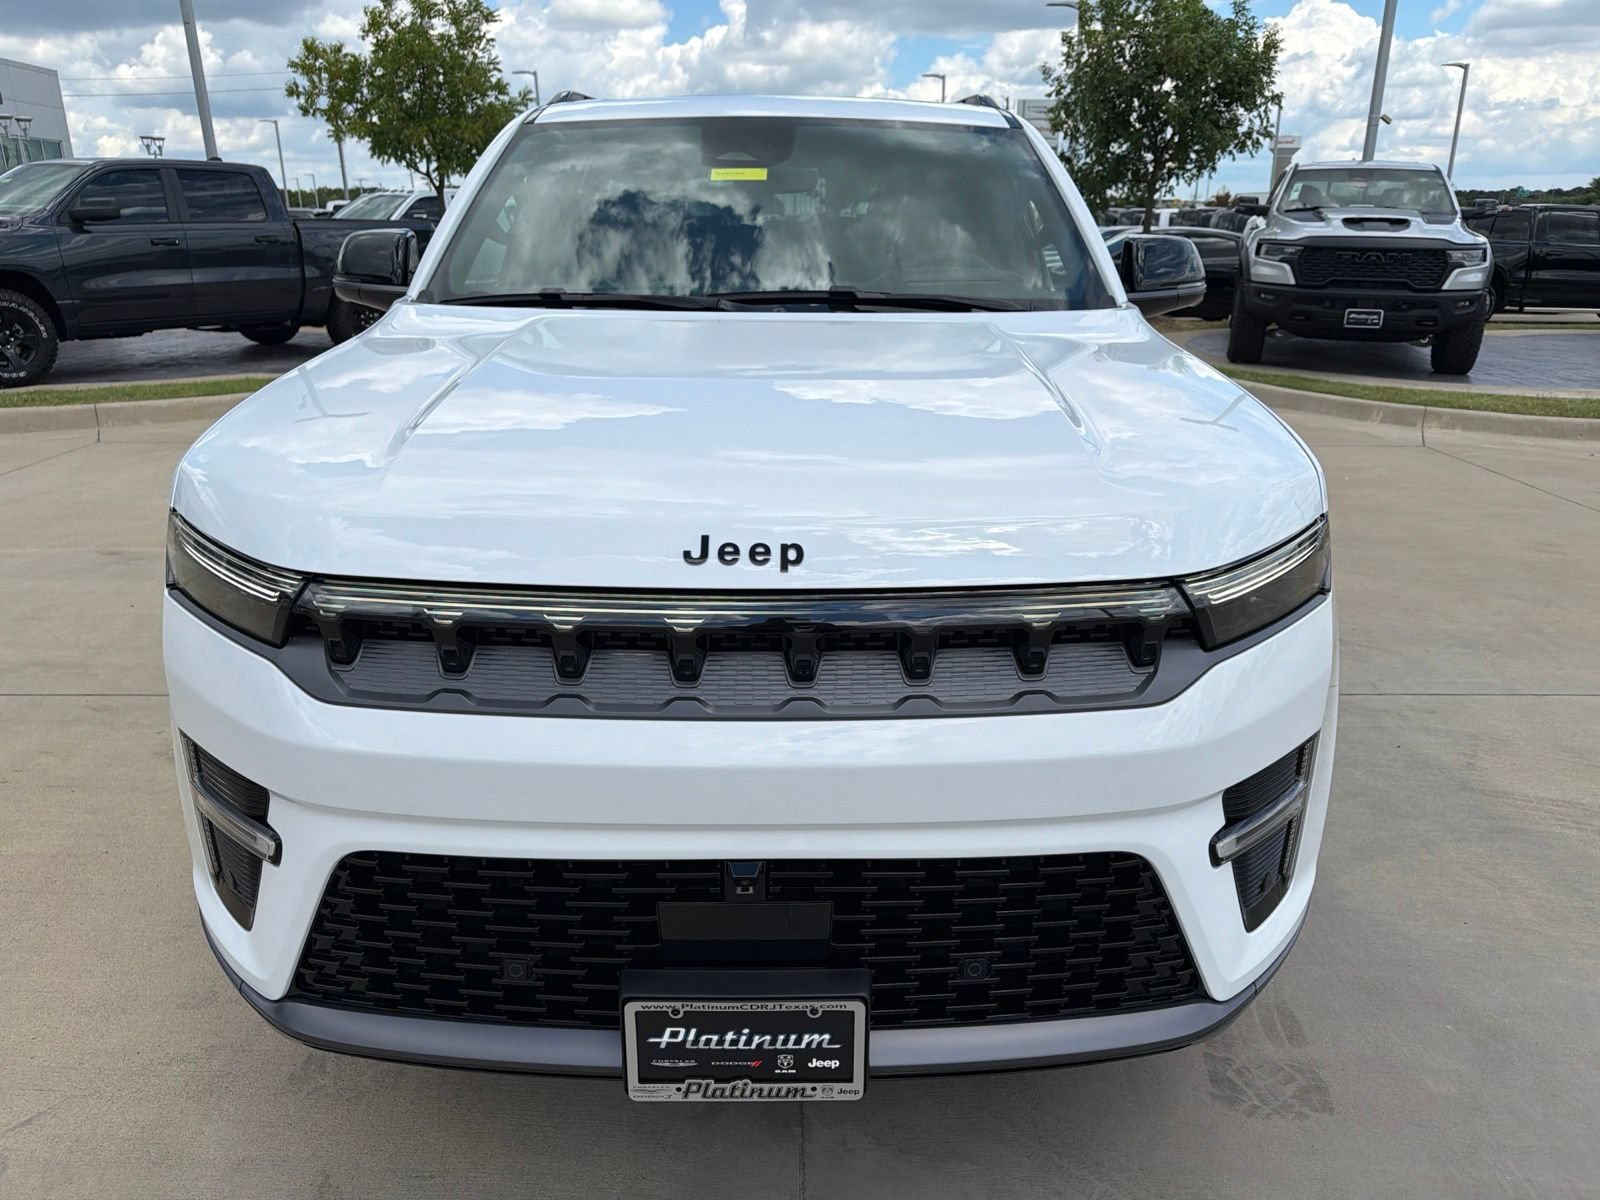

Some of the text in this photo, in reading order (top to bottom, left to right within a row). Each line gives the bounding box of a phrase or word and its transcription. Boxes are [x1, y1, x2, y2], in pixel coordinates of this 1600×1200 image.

[1335, 251, 1413, 266] RAM
[682, 534, 805, 573] Jeep
[641, 1003, 848, 1011] www.PlatinumCDRJTexas.com
[646, 1027, 842, 1050] Platinum
[808, 1058, 840, 1069] Jeep
[683, 1081, 817, 1099] Platinum
[837, 1087, 860, 1096] Jeep
